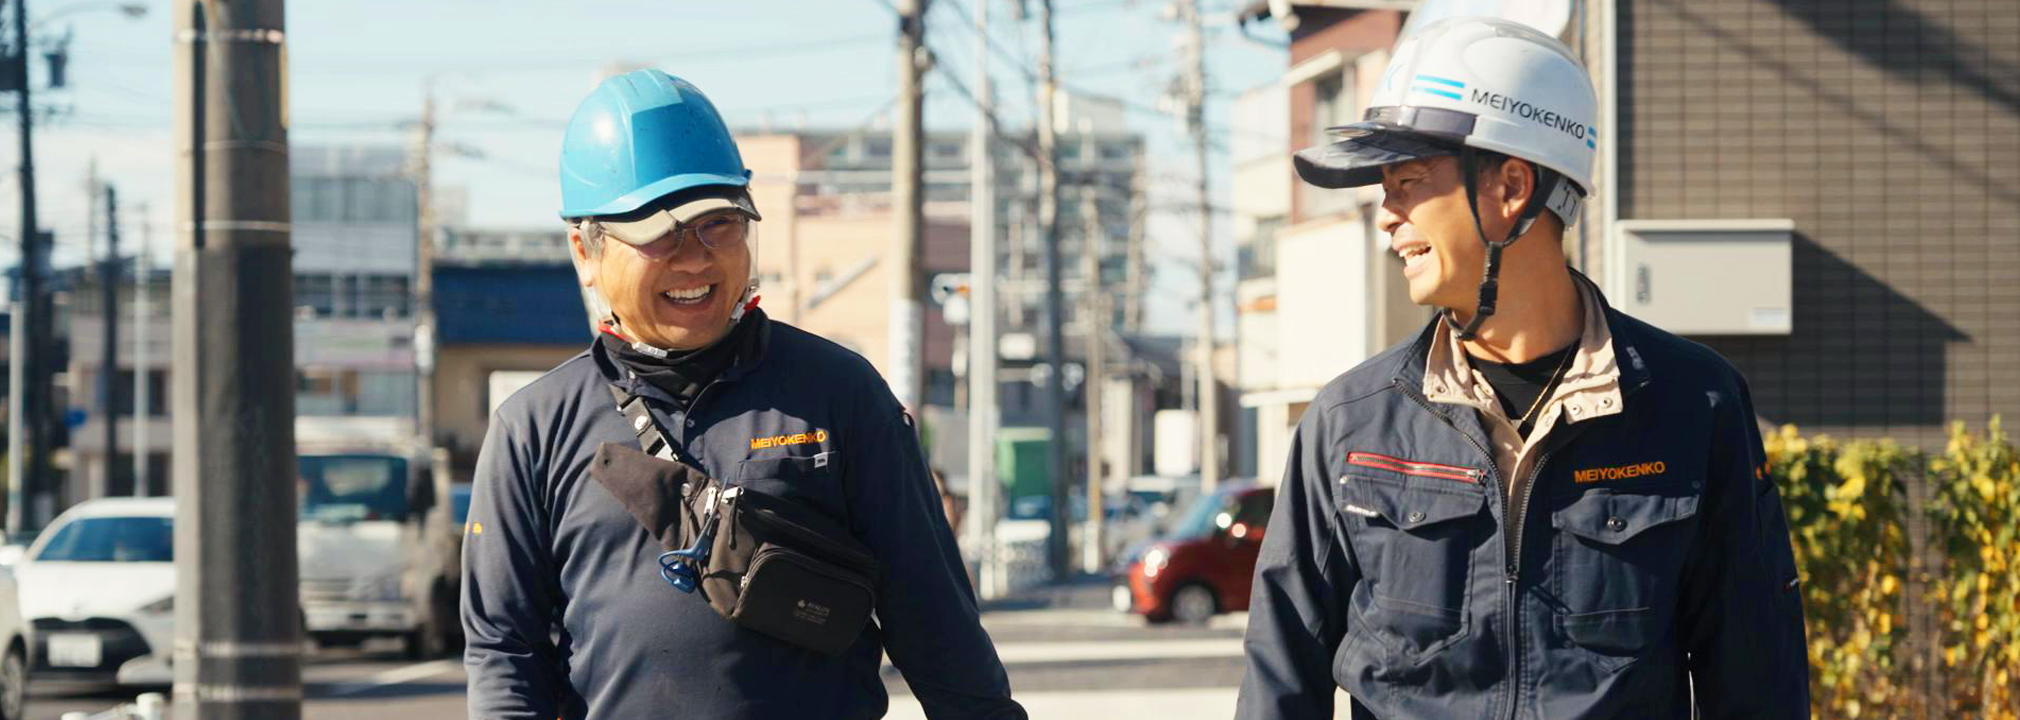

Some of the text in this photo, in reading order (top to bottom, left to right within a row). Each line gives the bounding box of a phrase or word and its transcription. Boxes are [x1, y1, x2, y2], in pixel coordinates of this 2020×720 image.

[1471, 88, 1585, 140] MEIYOKENKO
[751, 430, 826, 449] MEIYOKENKO
[1573, 460, 1665, 483] MEIYOKENKO
